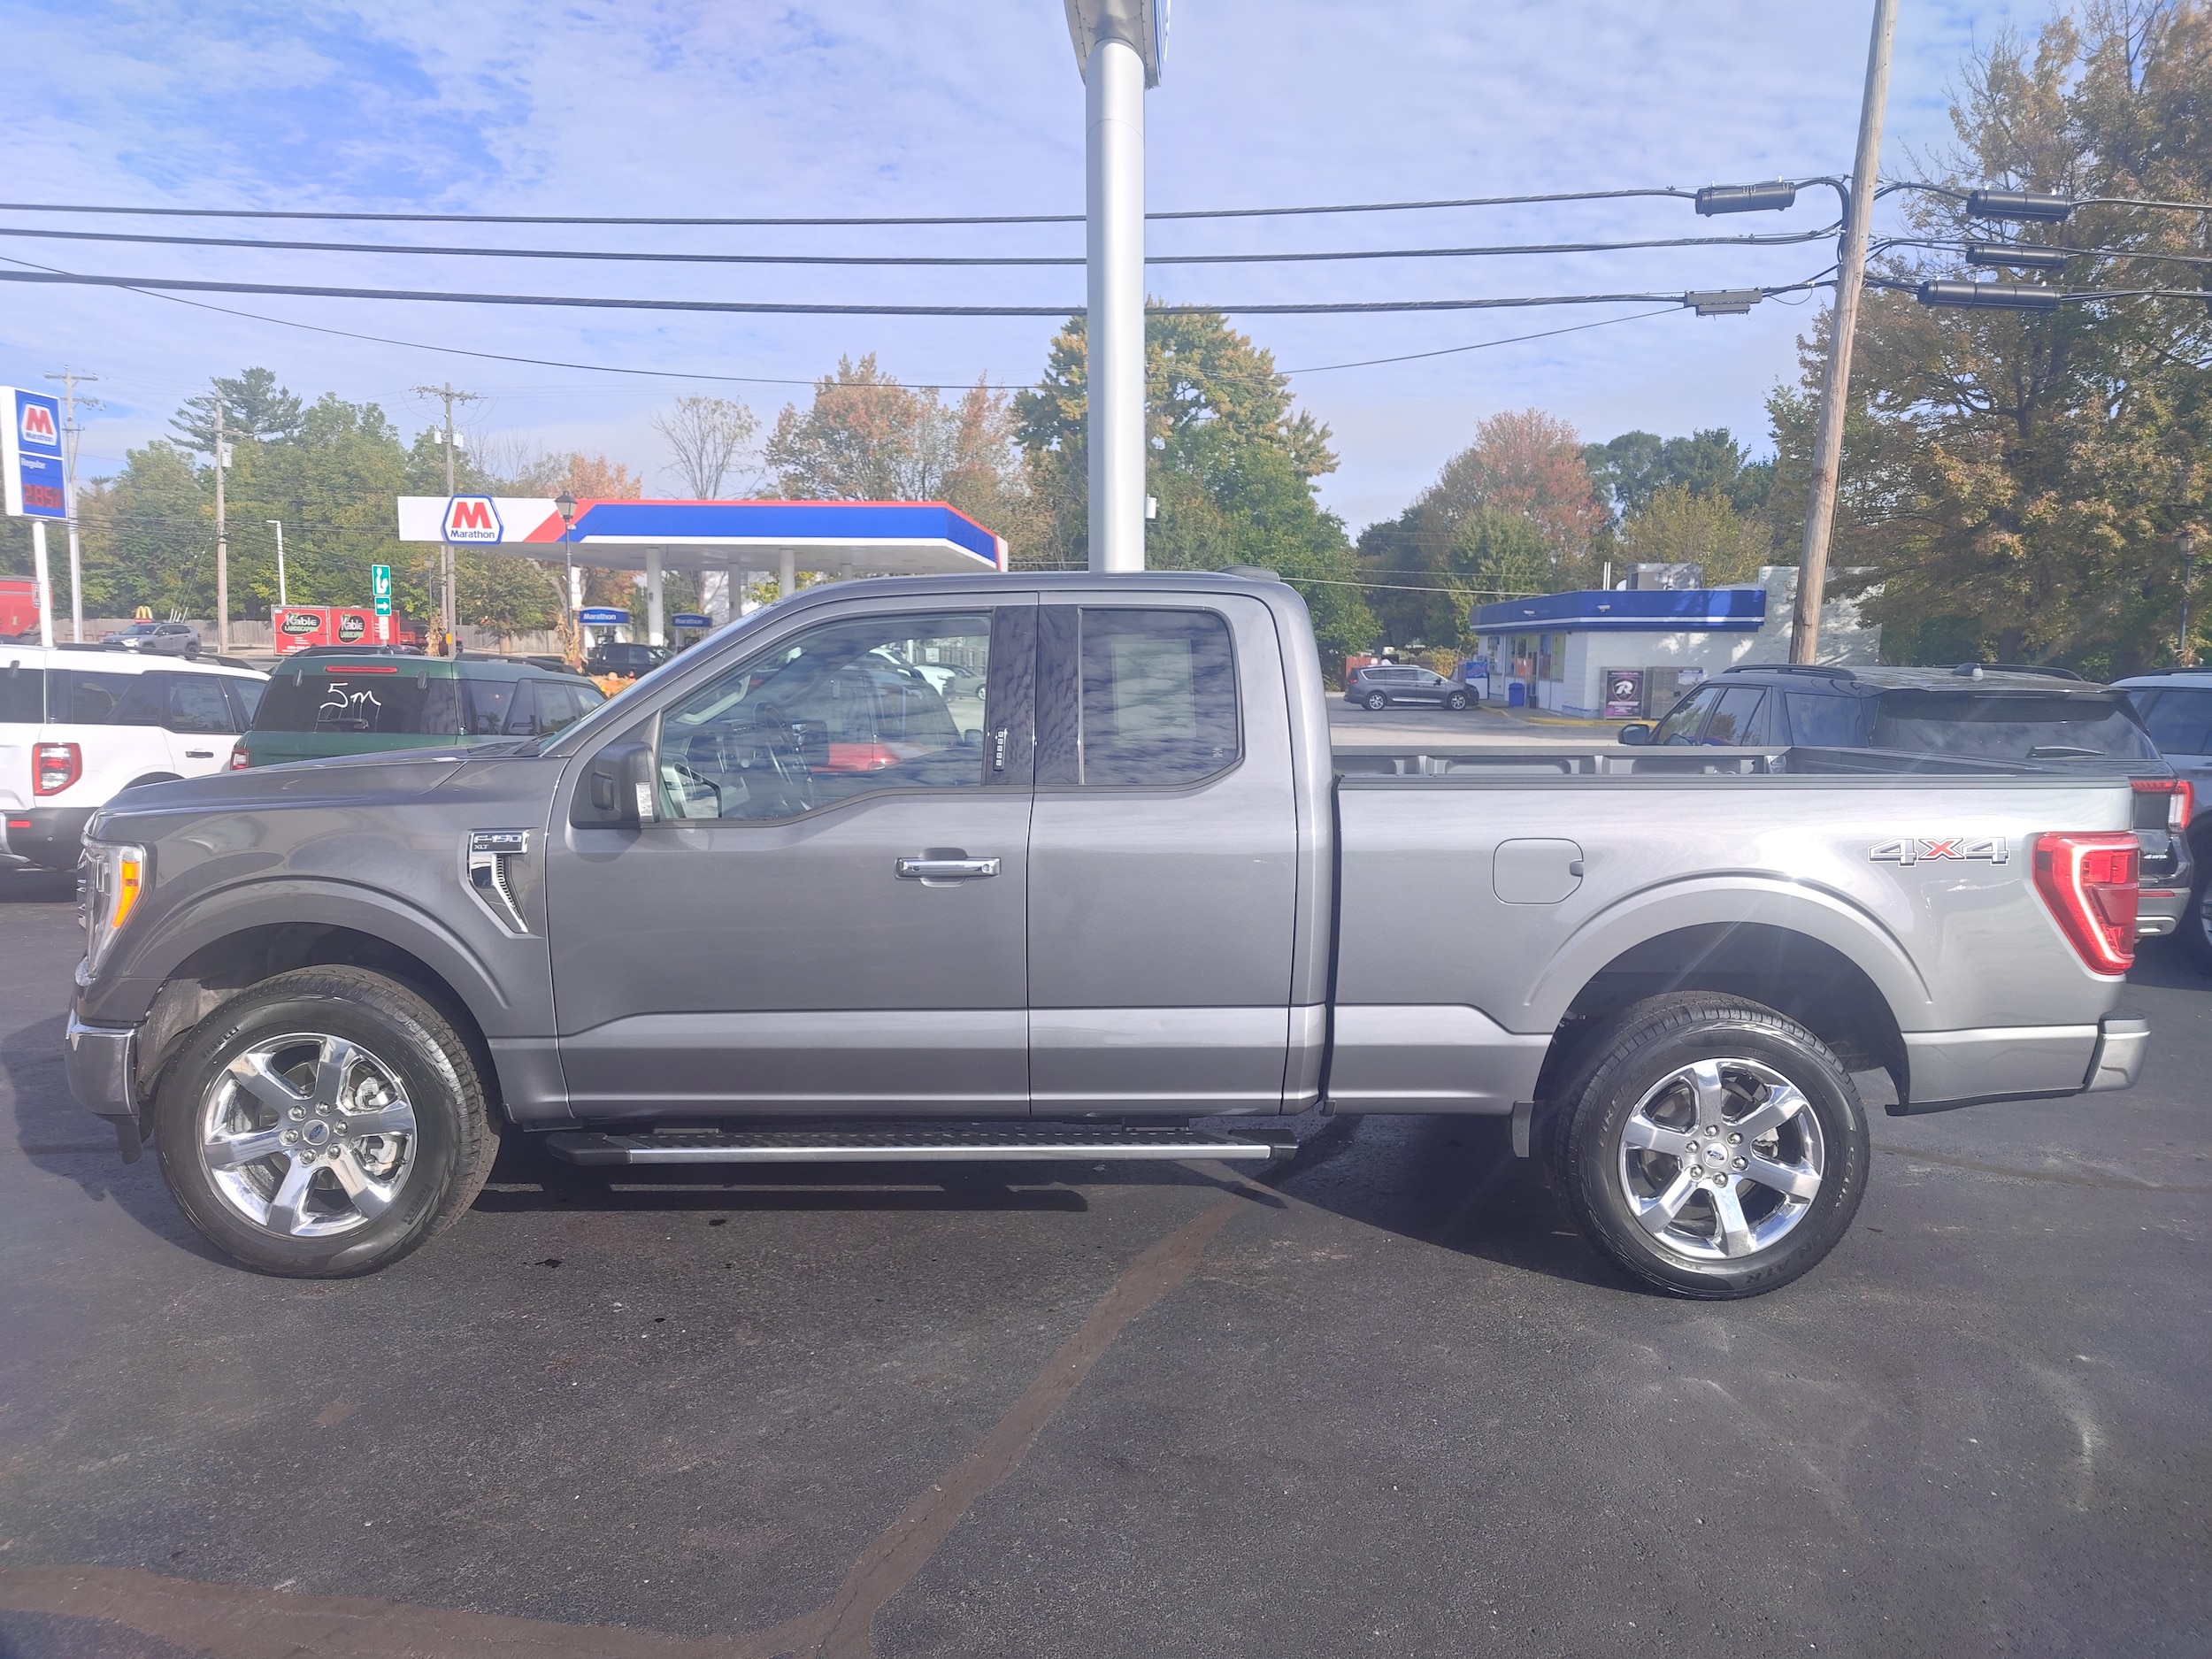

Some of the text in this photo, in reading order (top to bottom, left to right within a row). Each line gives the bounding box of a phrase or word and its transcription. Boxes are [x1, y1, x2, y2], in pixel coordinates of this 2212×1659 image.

[25, 431, 54, 443] Marathon
[20, 457, 46, 470] Regular
[451, 502, 493, 529] M
[450, 530, 495, 539] Marathon
[285, 613, 318, 626] Kable
[341, 615, 364, 631] Kable
[1615, 680, 1633, 694] R
[473, 834, 522, 843] F-150
